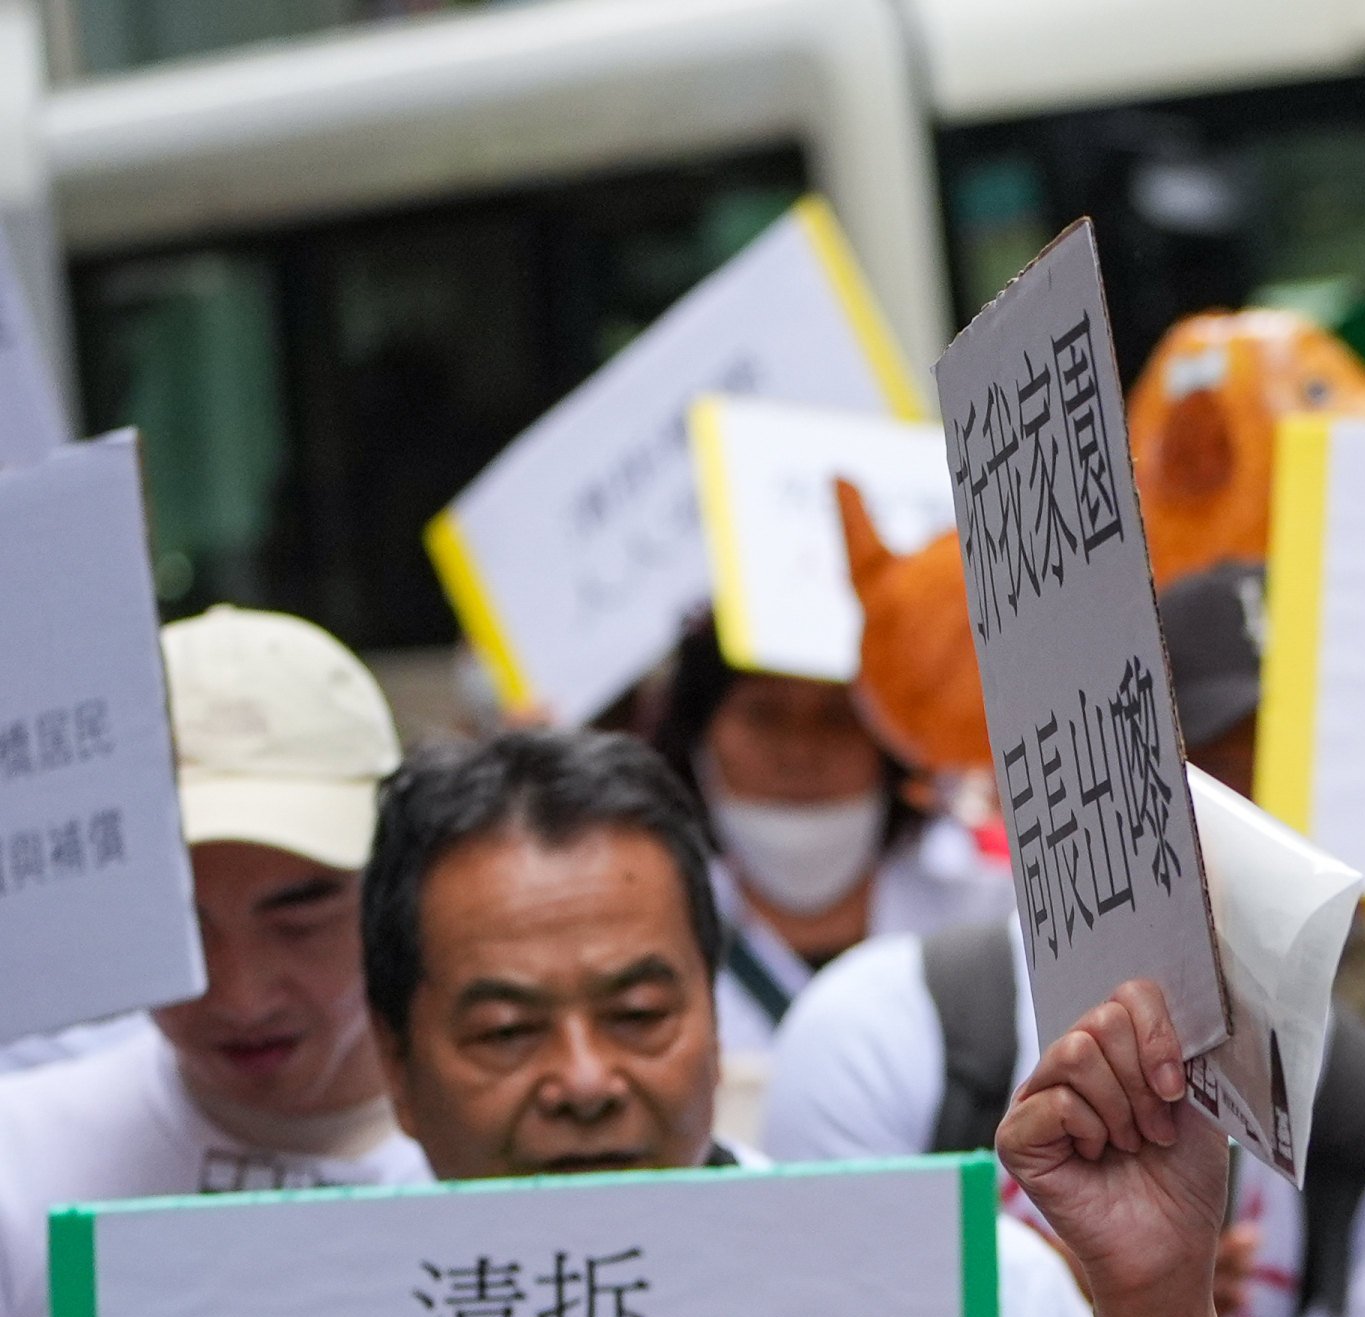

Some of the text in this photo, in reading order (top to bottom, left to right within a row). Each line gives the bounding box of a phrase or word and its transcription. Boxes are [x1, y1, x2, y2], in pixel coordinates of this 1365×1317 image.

[954, 307, 1124, 646] 拆我家園
[0, 807, 127, 896] 與補償
[1003, 655, 1182, 970] 局長出嚟
